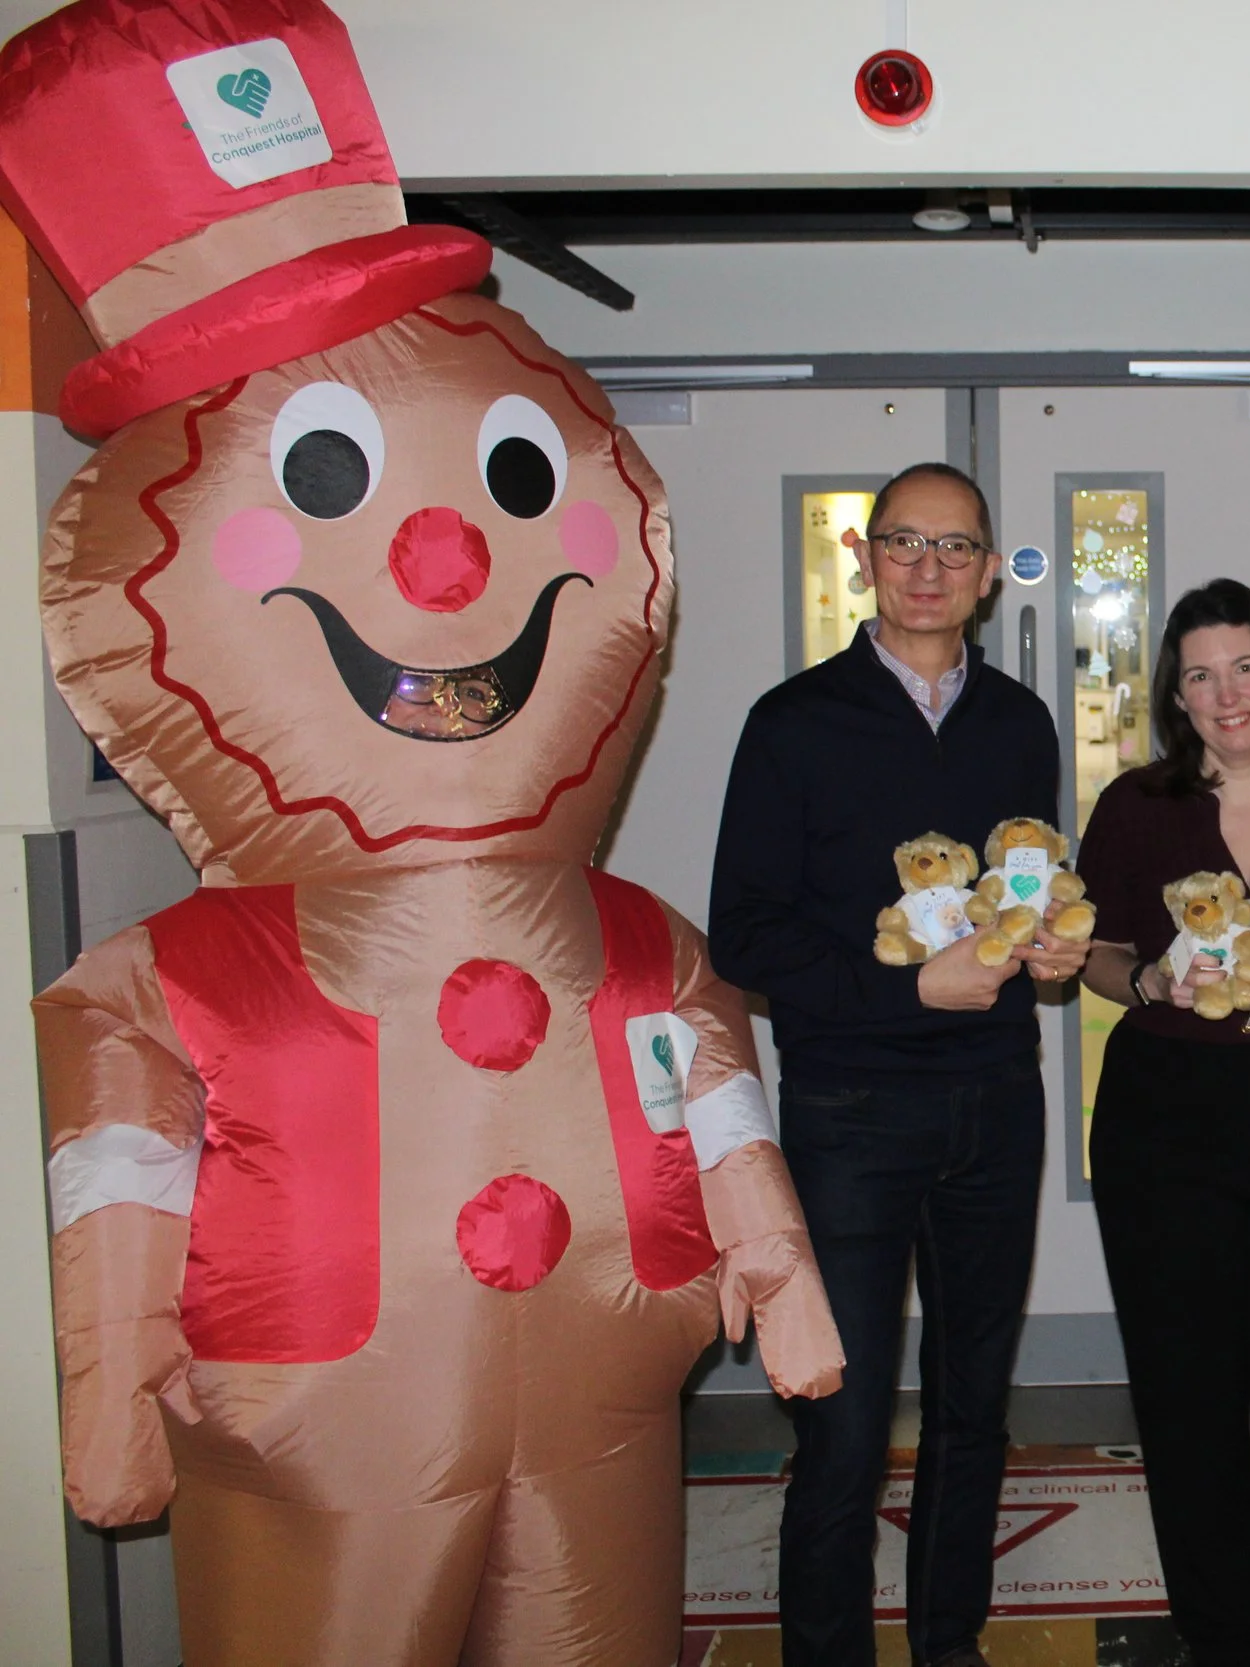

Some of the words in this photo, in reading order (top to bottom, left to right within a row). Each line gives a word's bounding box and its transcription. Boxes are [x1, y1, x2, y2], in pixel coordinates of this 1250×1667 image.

[219, 131, 246, 146] The
[246, 118, 290, 138] Friends
[288, 114, 304, 126] of
[211, 140, 275, 165] Conquest
[276, 124, 322, 146] Hospital
[1029, 1483, 1117, 1495] clinical
[997, 1578, 1109, 1593] cleanse
[682, 1590, 752, 1602] ease
